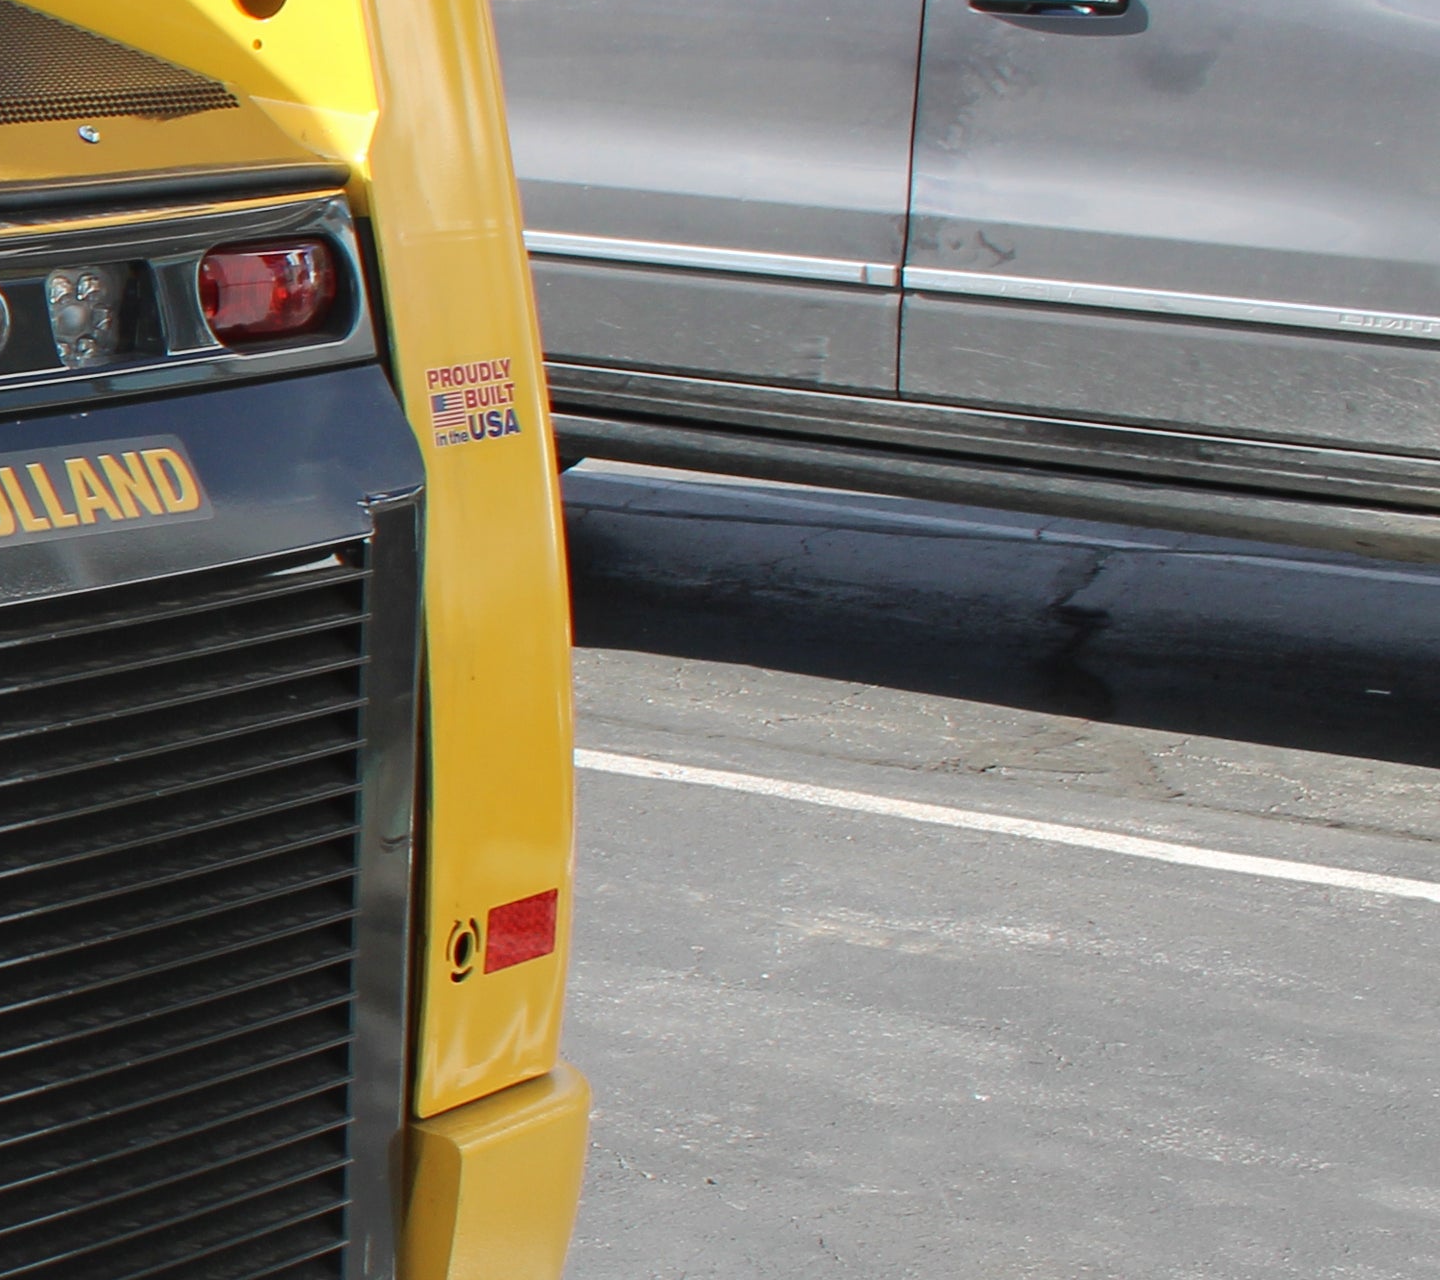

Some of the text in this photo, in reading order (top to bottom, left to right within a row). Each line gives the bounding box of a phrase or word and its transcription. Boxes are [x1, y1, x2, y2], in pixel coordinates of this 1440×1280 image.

[427, 359, 512, 390] PROUDLY
[465, 383, 516, 409] BUILT
[435, 409, 521, 448] in the USA
